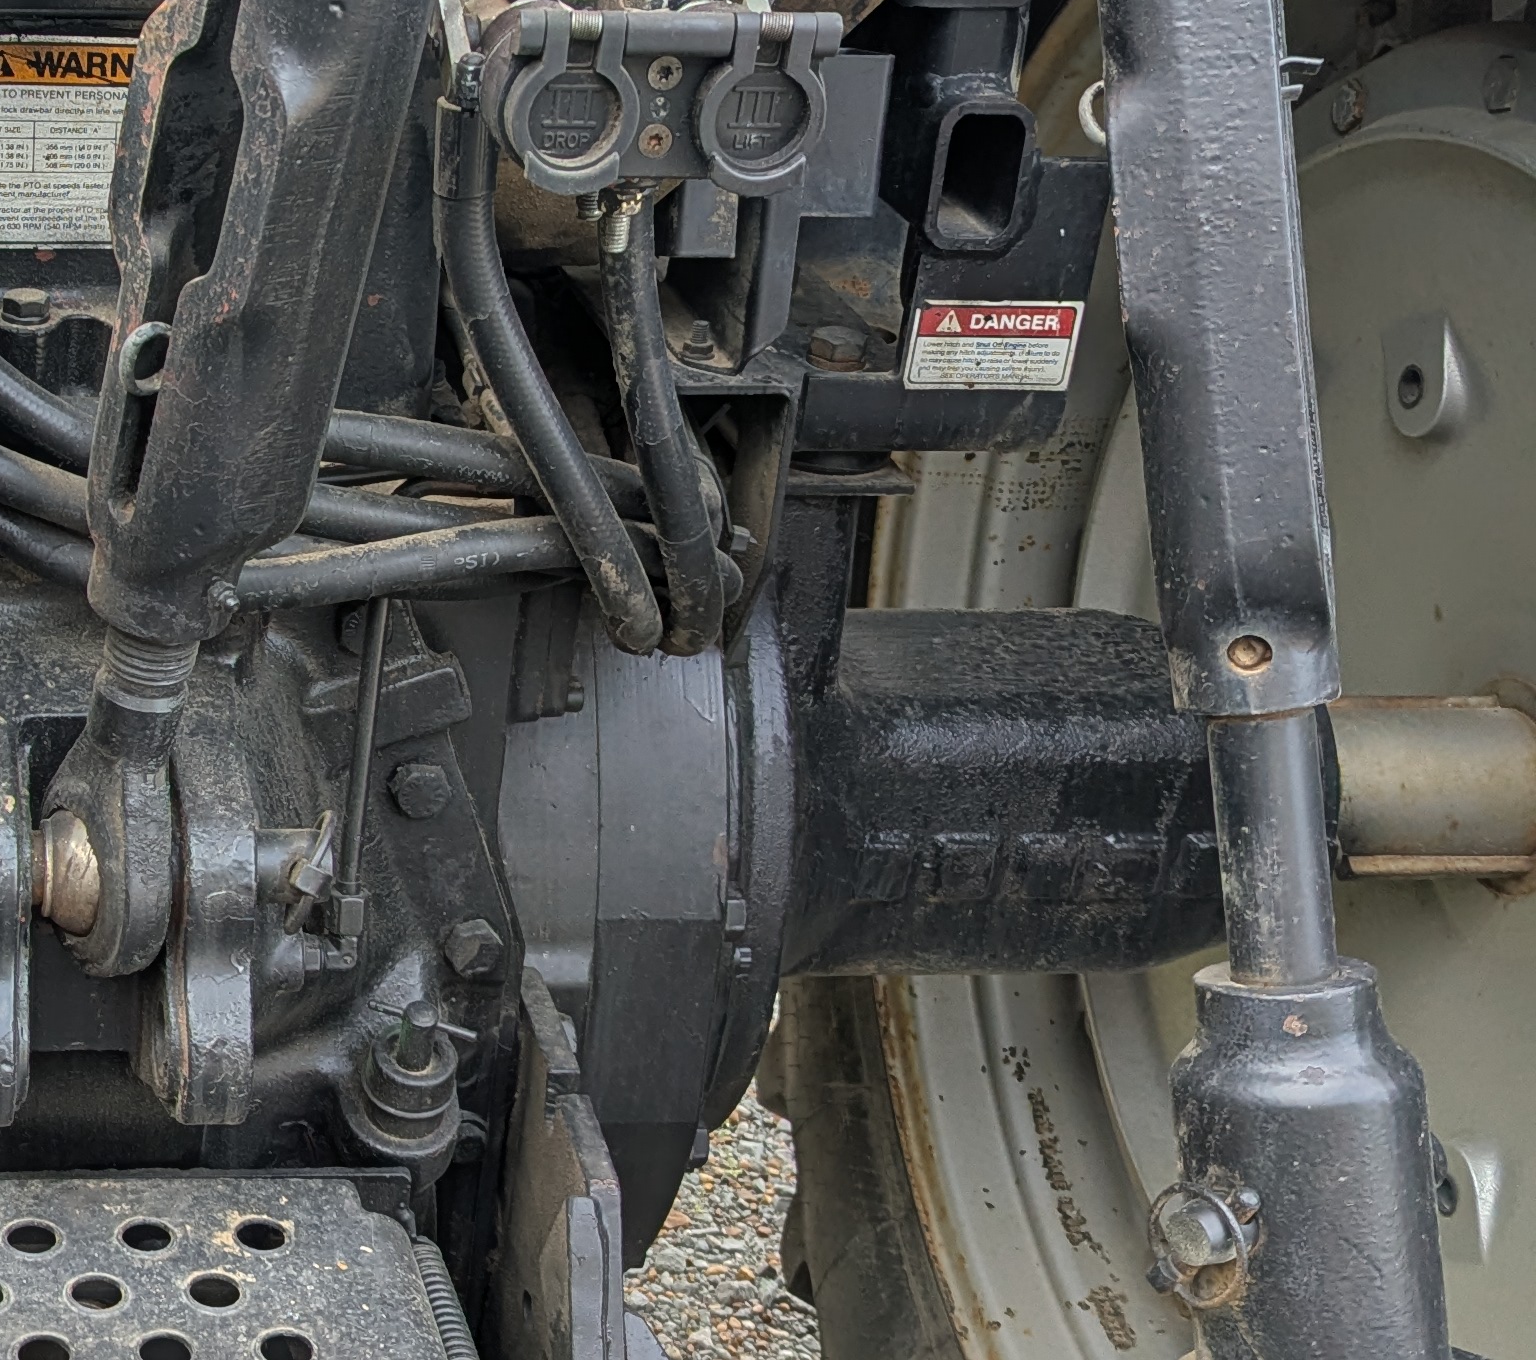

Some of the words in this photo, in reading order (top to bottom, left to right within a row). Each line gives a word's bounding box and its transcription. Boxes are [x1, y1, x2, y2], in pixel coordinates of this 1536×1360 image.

[1, 89, 18, 99] TO
[20, 89, 72, 100] PREVENT
[542, 131, 593, 151] DROP
[732, 132, 773, 151] LIFT
[23, 181, 42, 189] PTO
[52, 182, 81, 190] speeds
[75, 206, 93, 214] PTO
[22, 222, 42, 230] RPM
[969, 313, 1059, 331] DANGER
[1004, 342, 1027, 350] Engine
[1029, 358, 1059, 366] suddenly
